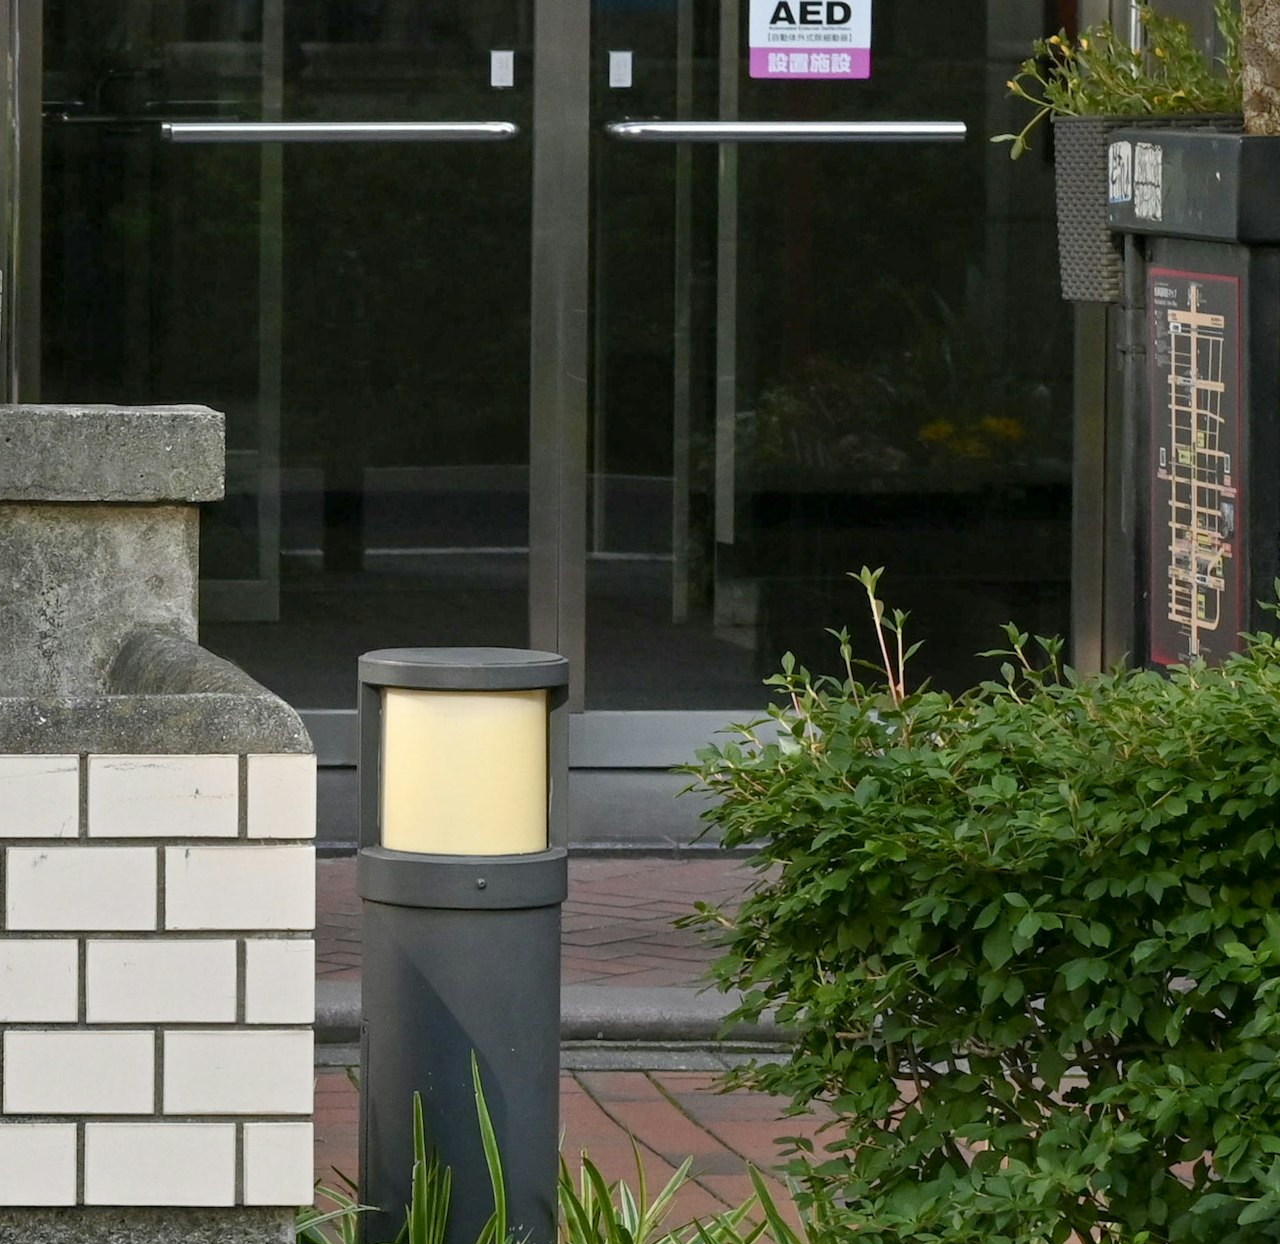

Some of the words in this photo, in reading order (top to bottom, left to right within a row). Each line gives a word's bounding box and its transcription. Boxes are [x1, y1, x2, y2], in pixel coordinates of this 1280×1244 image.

[769, 1, 852, 25] AED
[768, 53, 852, 73] 設置施設
